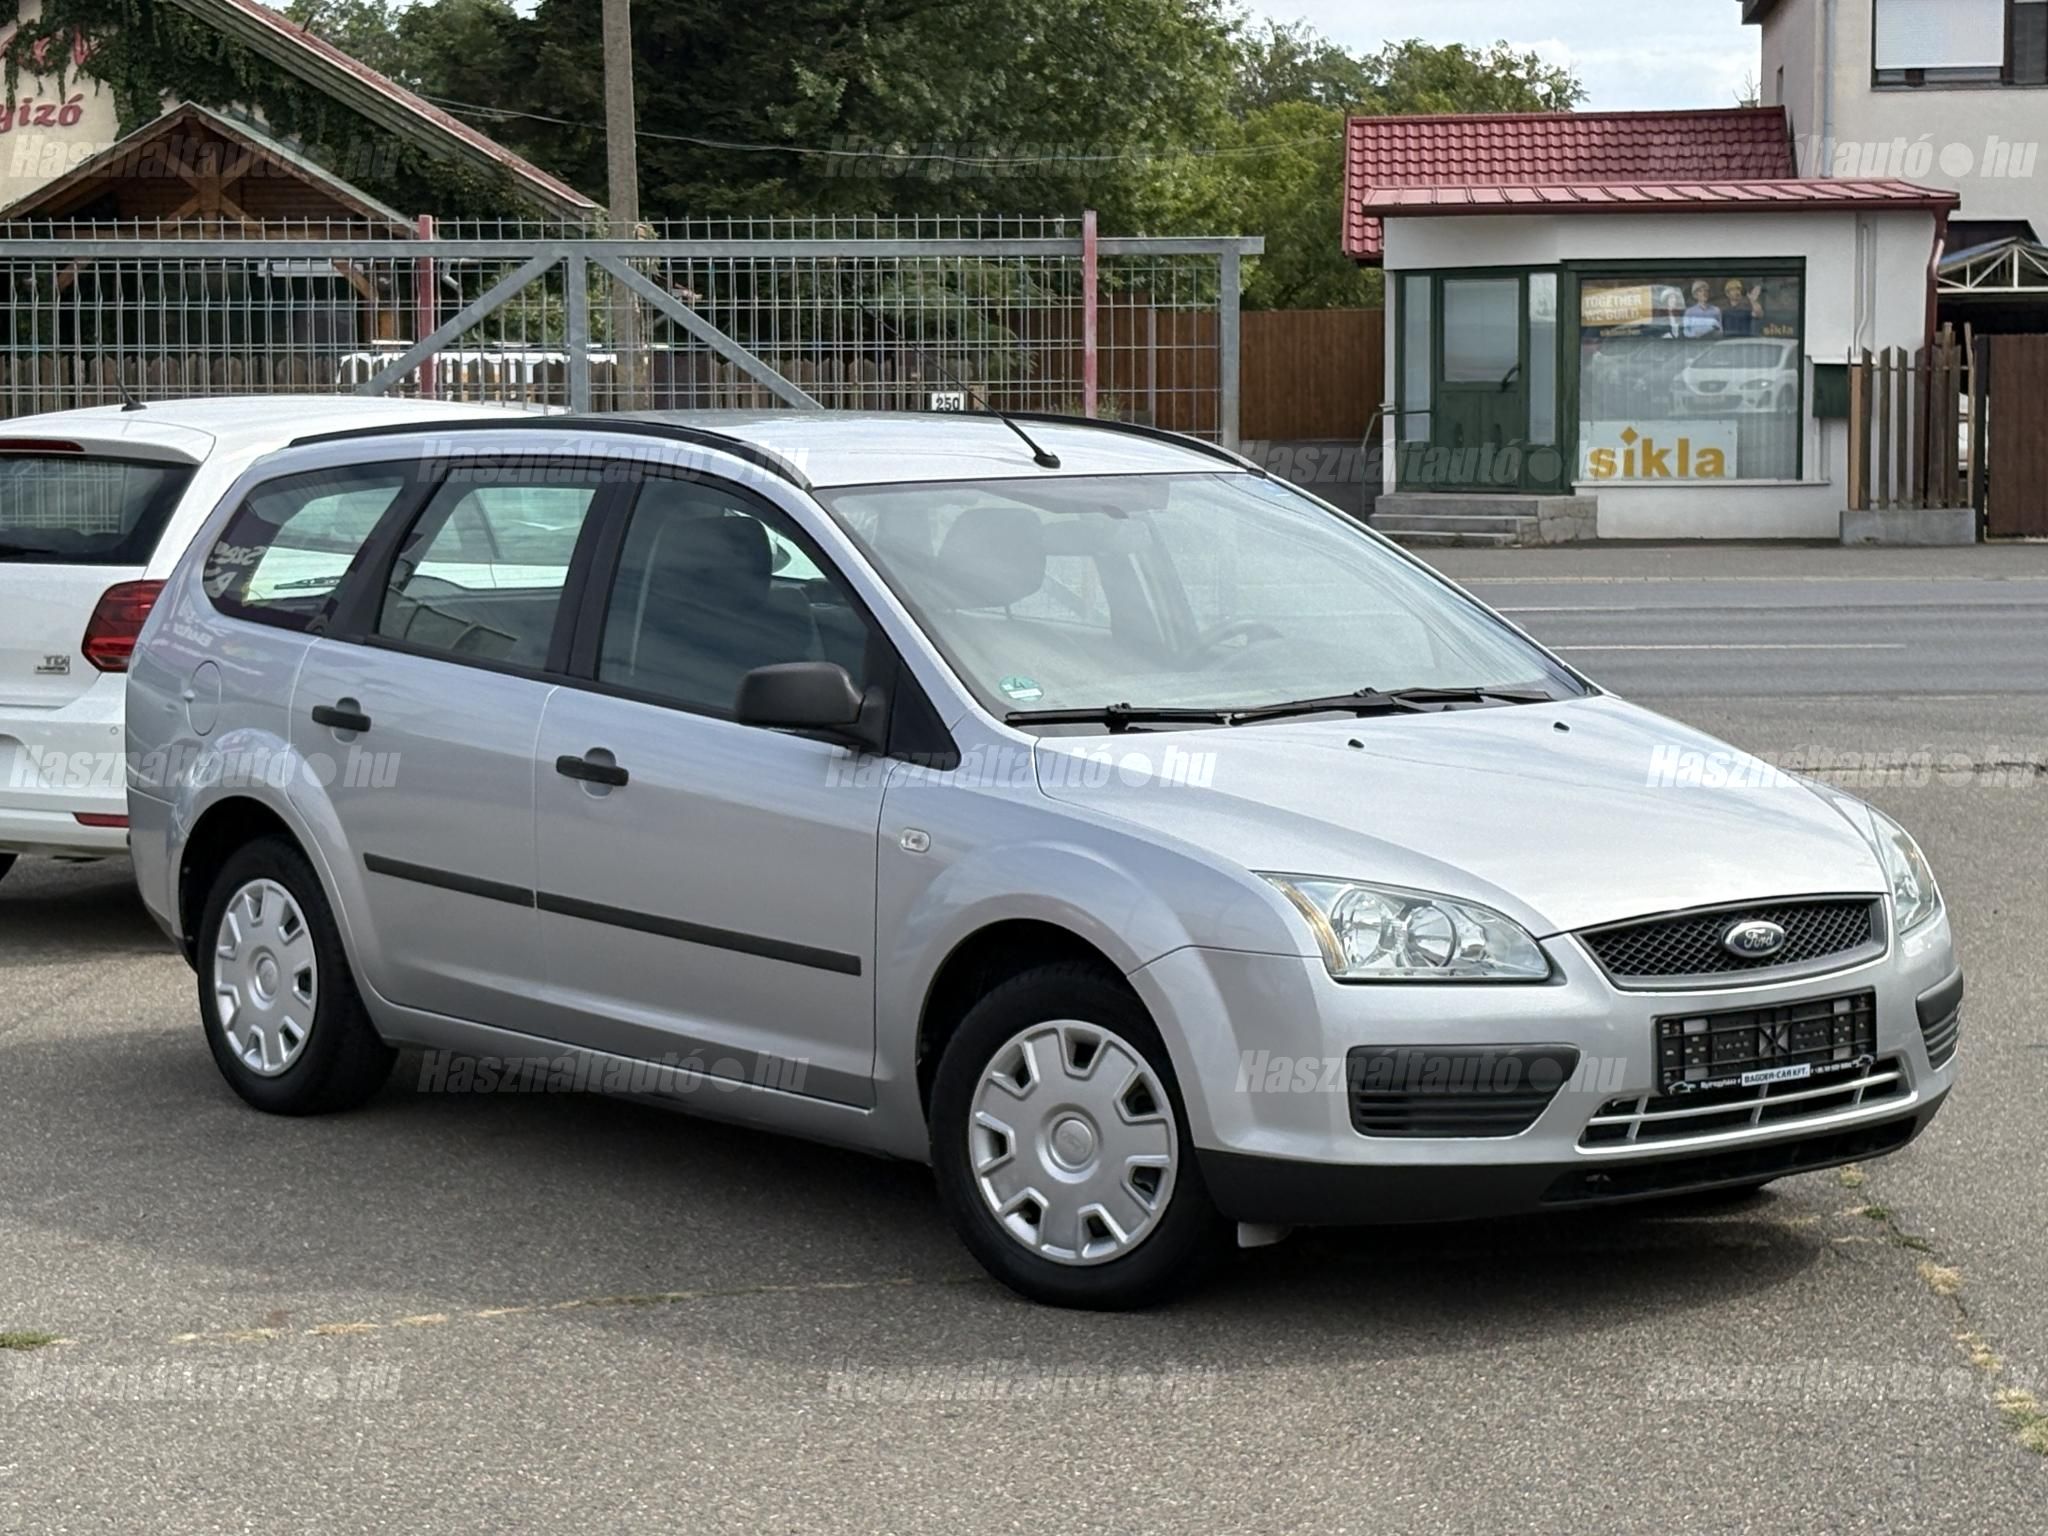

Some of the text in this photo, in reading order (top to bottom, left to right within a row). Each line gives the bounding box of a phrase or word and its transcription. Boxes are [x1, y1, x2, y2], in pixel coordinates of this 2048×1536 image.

[1583, 294, 1642, 307] TOGETHER
[1763, 322, 1794, 336] sikla
[936, 396, 960, 411] 250
[1588, 426, 1726, 480] sikla
[1743, 928, 1774, 949] Ford
